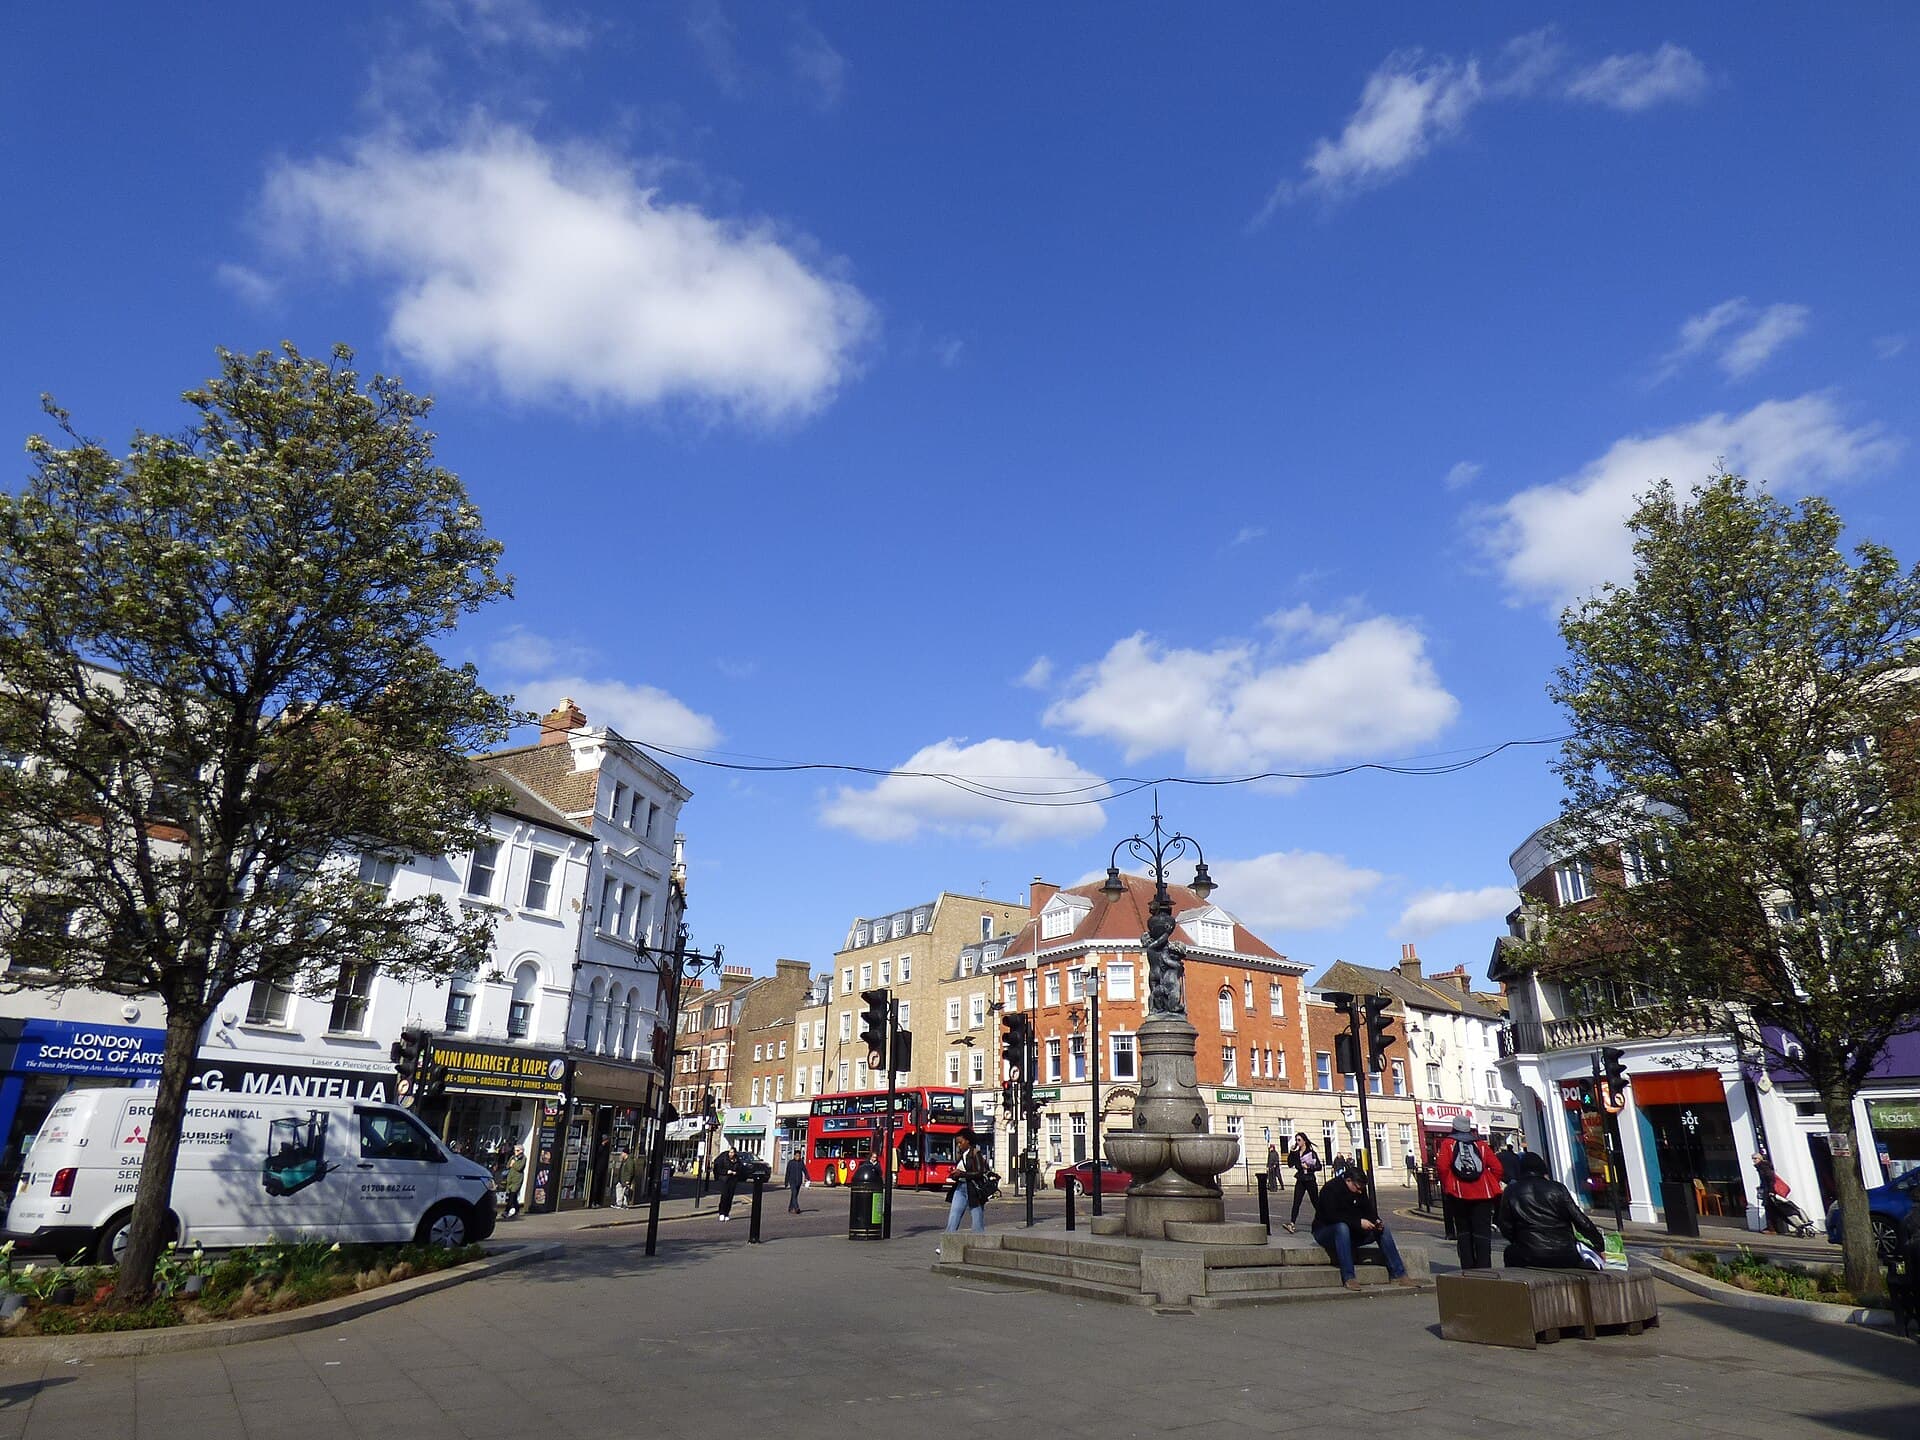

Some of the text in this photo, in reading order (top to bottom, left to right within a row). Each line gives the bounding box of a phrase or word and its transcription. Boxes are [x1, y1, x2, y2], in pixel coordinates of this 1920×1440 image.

[73, 1033, 143, 1050] LONDON
[39, 1045, 165, 1065] SCHOOL OF ARTS
[56, 1063, 90, 1072] Performing
[103, 1065, 129, 1075] Academy
[342, 1061, 372, 1071] Piercing
[434, 1049, 549, 1076] MINI MARKET & VAPE
[242, 1072, 386, 1103] MANTELLA
[456, 1074, 477, 1084] SHISHA
[479, 1076, 509, 1087] GROCERIES
[511, 1079, 523, 1089] SOFT
[128, 1106, 263, 1120] BRO MECHANICAL
[1878, 1112, 1914, 1124] haart
[179, 1131, 233, 1140] SUBISHI
[121, 1156, 143, 1166] SAL
